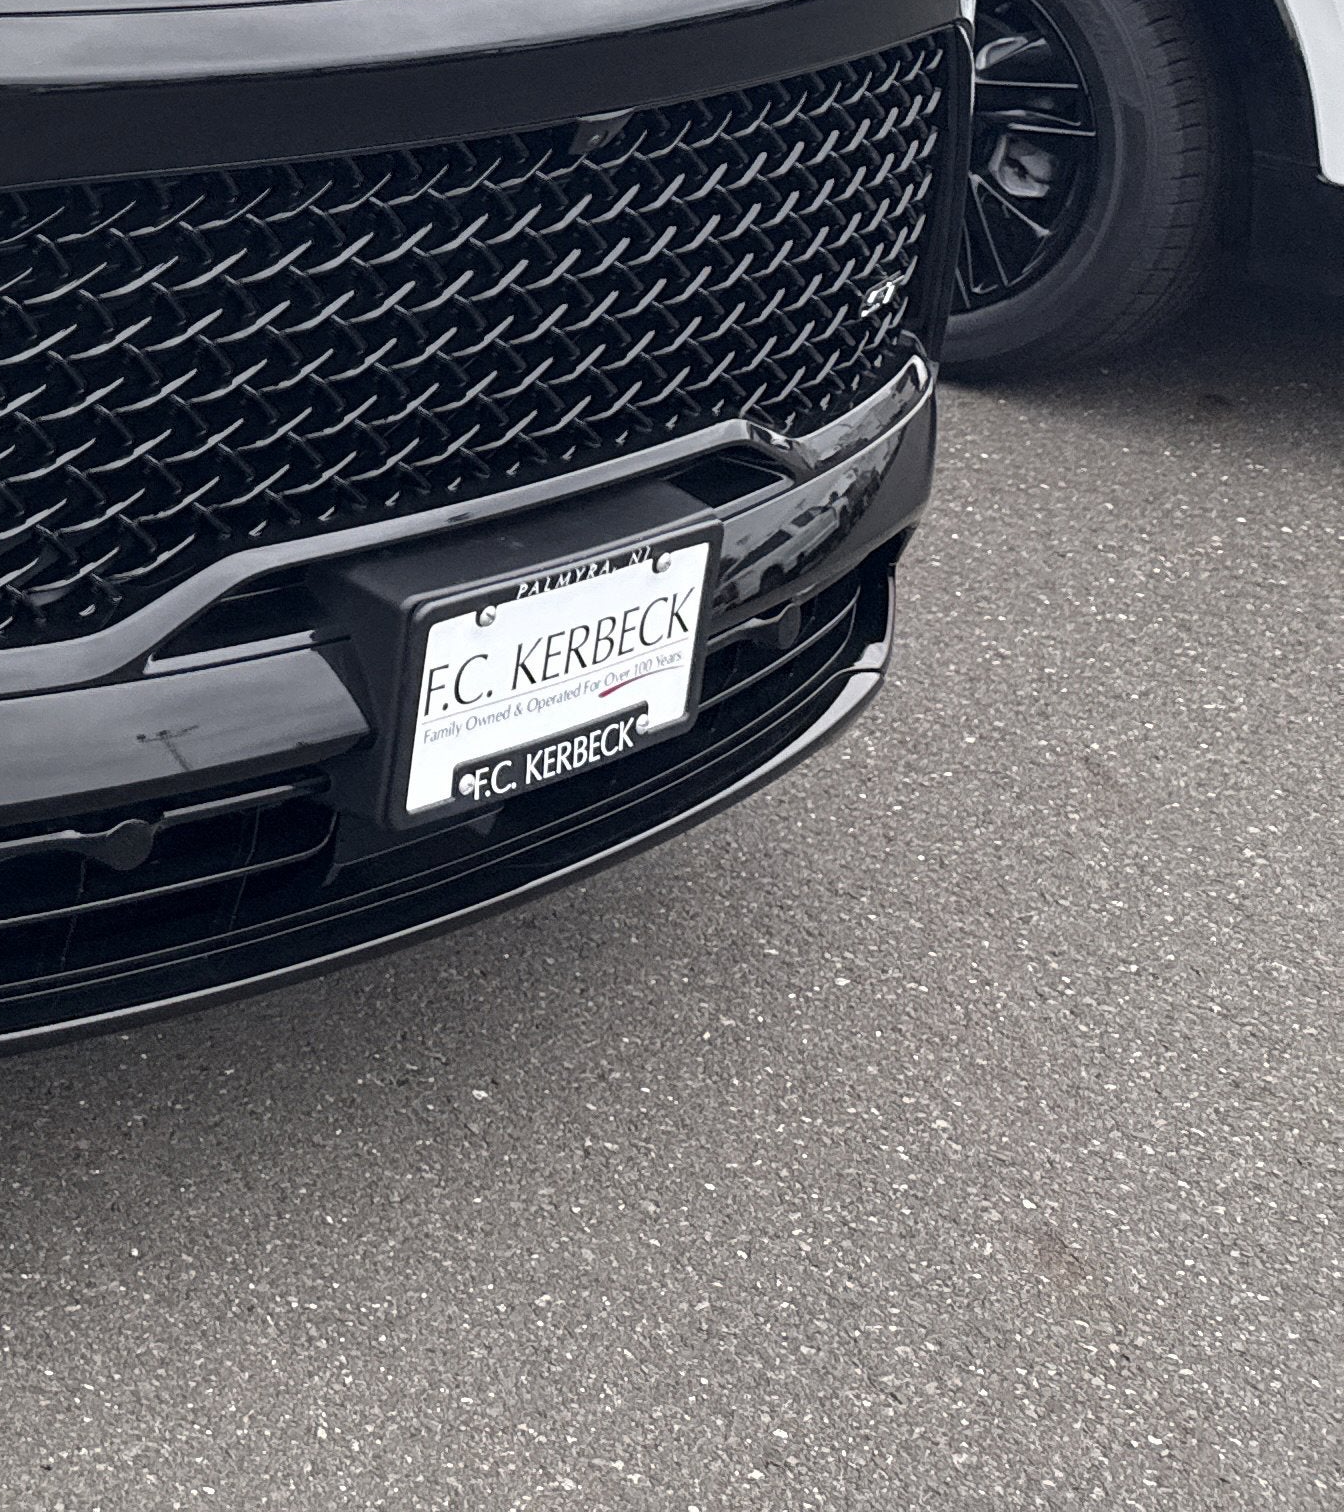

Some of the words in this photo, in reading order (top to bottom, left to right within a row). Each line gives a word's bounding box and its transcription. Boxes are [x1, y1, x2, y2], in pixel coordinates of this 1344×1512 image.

[424, 654, 493, 717] F.C.
[511, 586, 696, 690] KERBECK
[424, 721, 462, 744] Family
[466, 704, 512, 731] Owned
[513, 702, 524, 717] &
[526, 682, 581, 713] Operated
[583, 679, 601, 695] For
[604, 670, 630, 687] Over
[634, 658, 653, 675] 100
[656, 651, 682, 667] Years
[473, 760, 517, 801] F.C.
[525, 717, 635, 785] KERBECK
